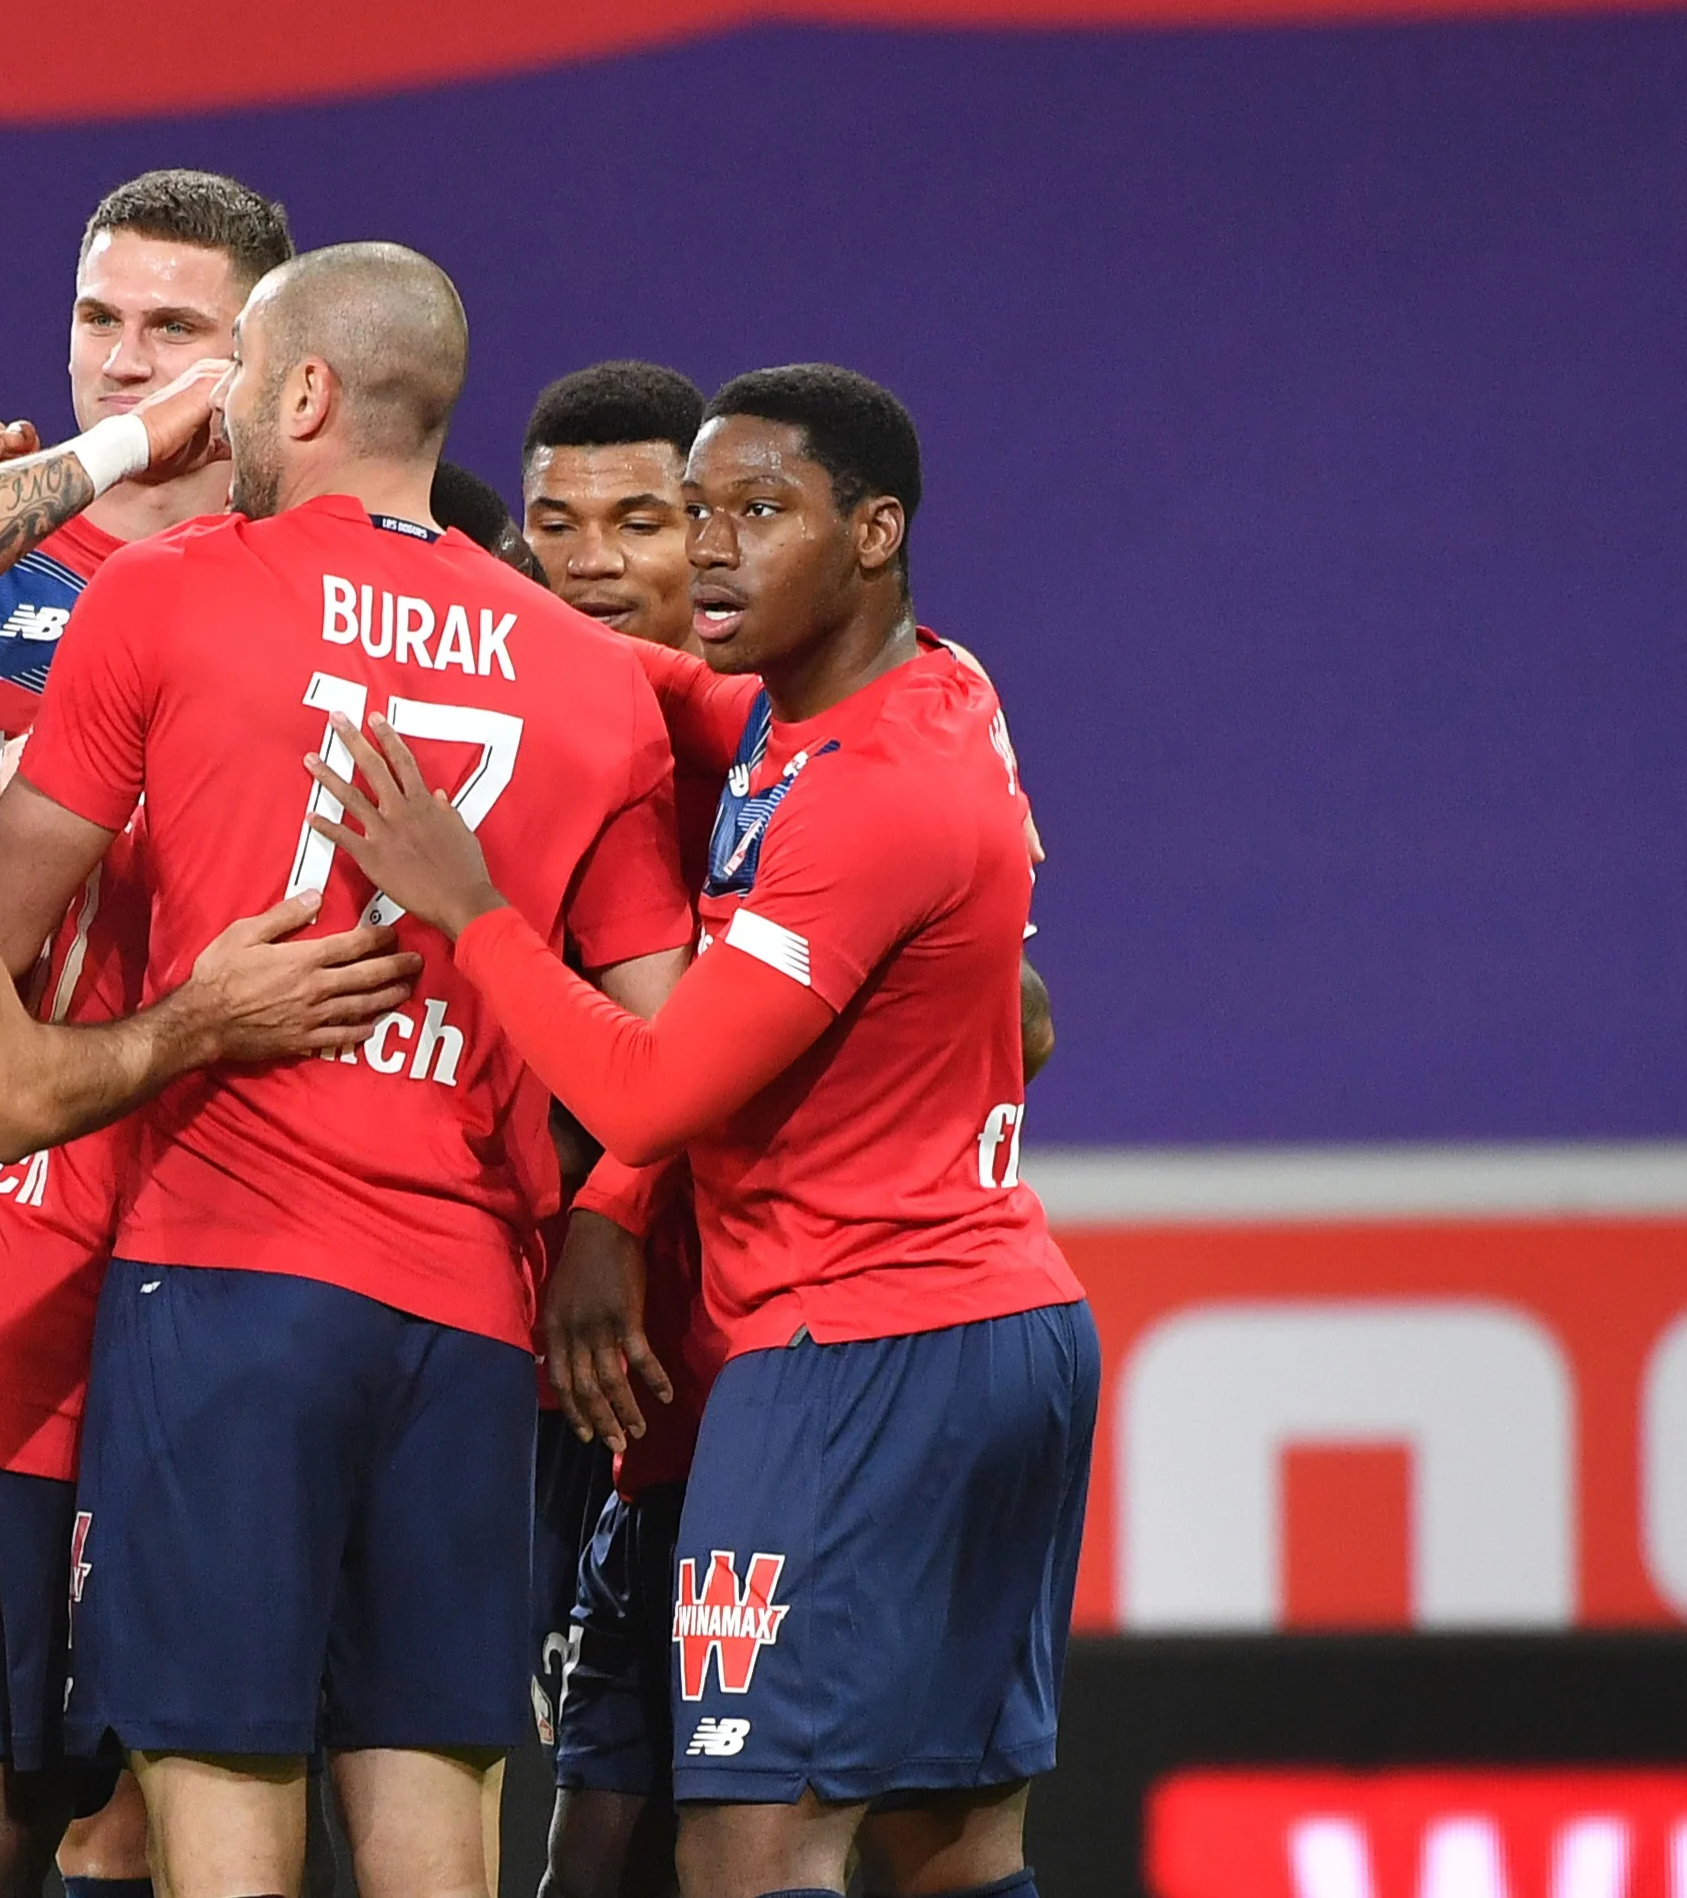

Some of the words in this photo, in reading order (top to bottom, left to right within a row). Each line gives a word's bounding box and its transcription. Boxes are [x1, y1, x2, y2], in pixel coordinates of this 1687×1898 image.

[322, 574, 518, 681] BURAK
[287, 671, 525, 929] 17
[678, 1604, 773, 1641] WINAMAX
[685, 1717, 751, 1756] NB
